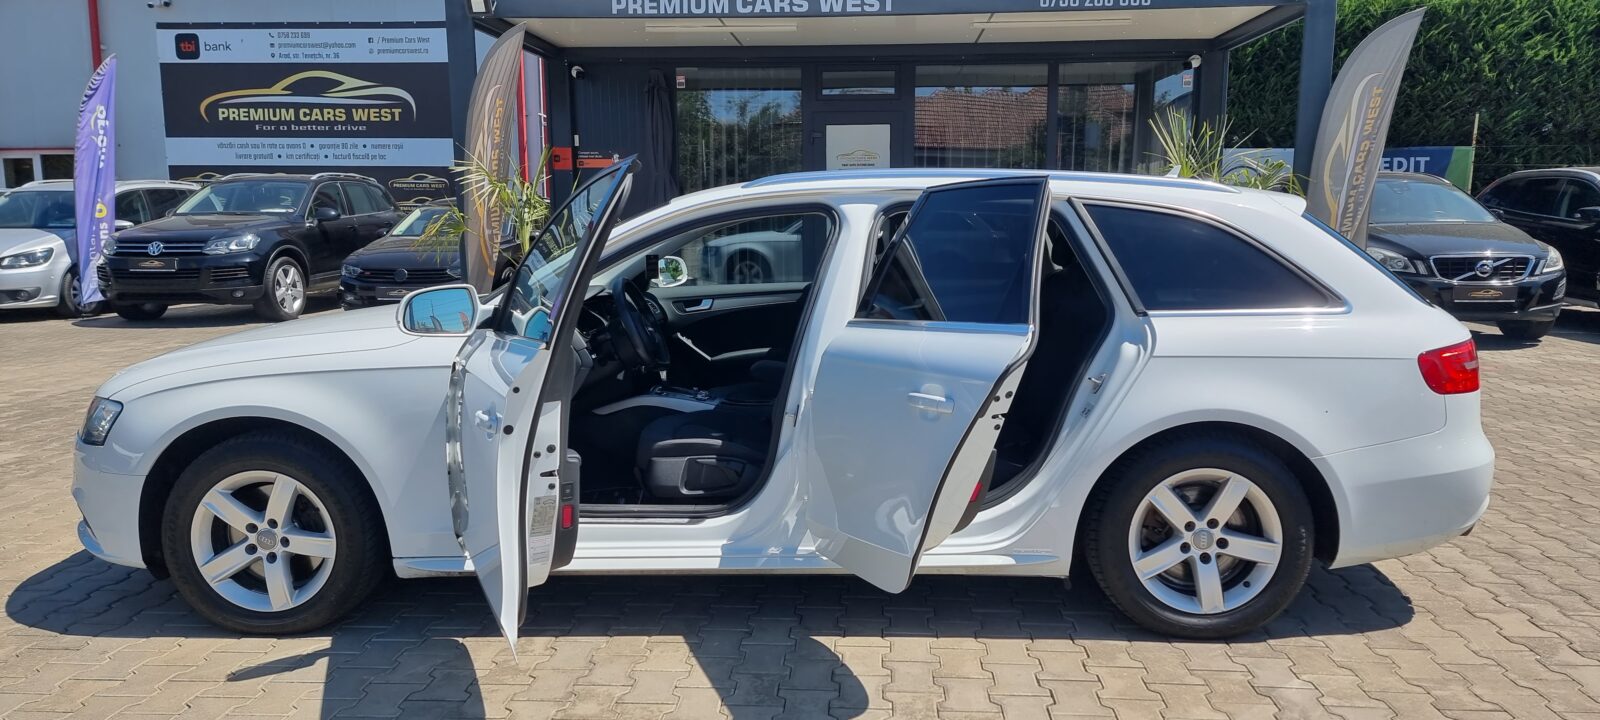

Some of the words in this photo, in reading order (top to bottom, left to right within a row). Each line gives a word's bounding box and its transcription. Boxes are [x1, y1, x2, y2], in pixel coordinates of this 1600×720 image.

[611, 0, 729, 14] PREMIUM
[736, 0, 809, 13] CARS
[819, 0, 895, 12] WEST
[180, 41, 195, 51] tbi
[204, 41, 232, 51] bank
[218, 108, 295, 121] PREMIUM
[299, 108, 346, 121] CARS
[351, 108, 402, 121] WEST
[1363, 87, 1385, 135] WEST
[1380, 156, 1430, 172] EDIT
